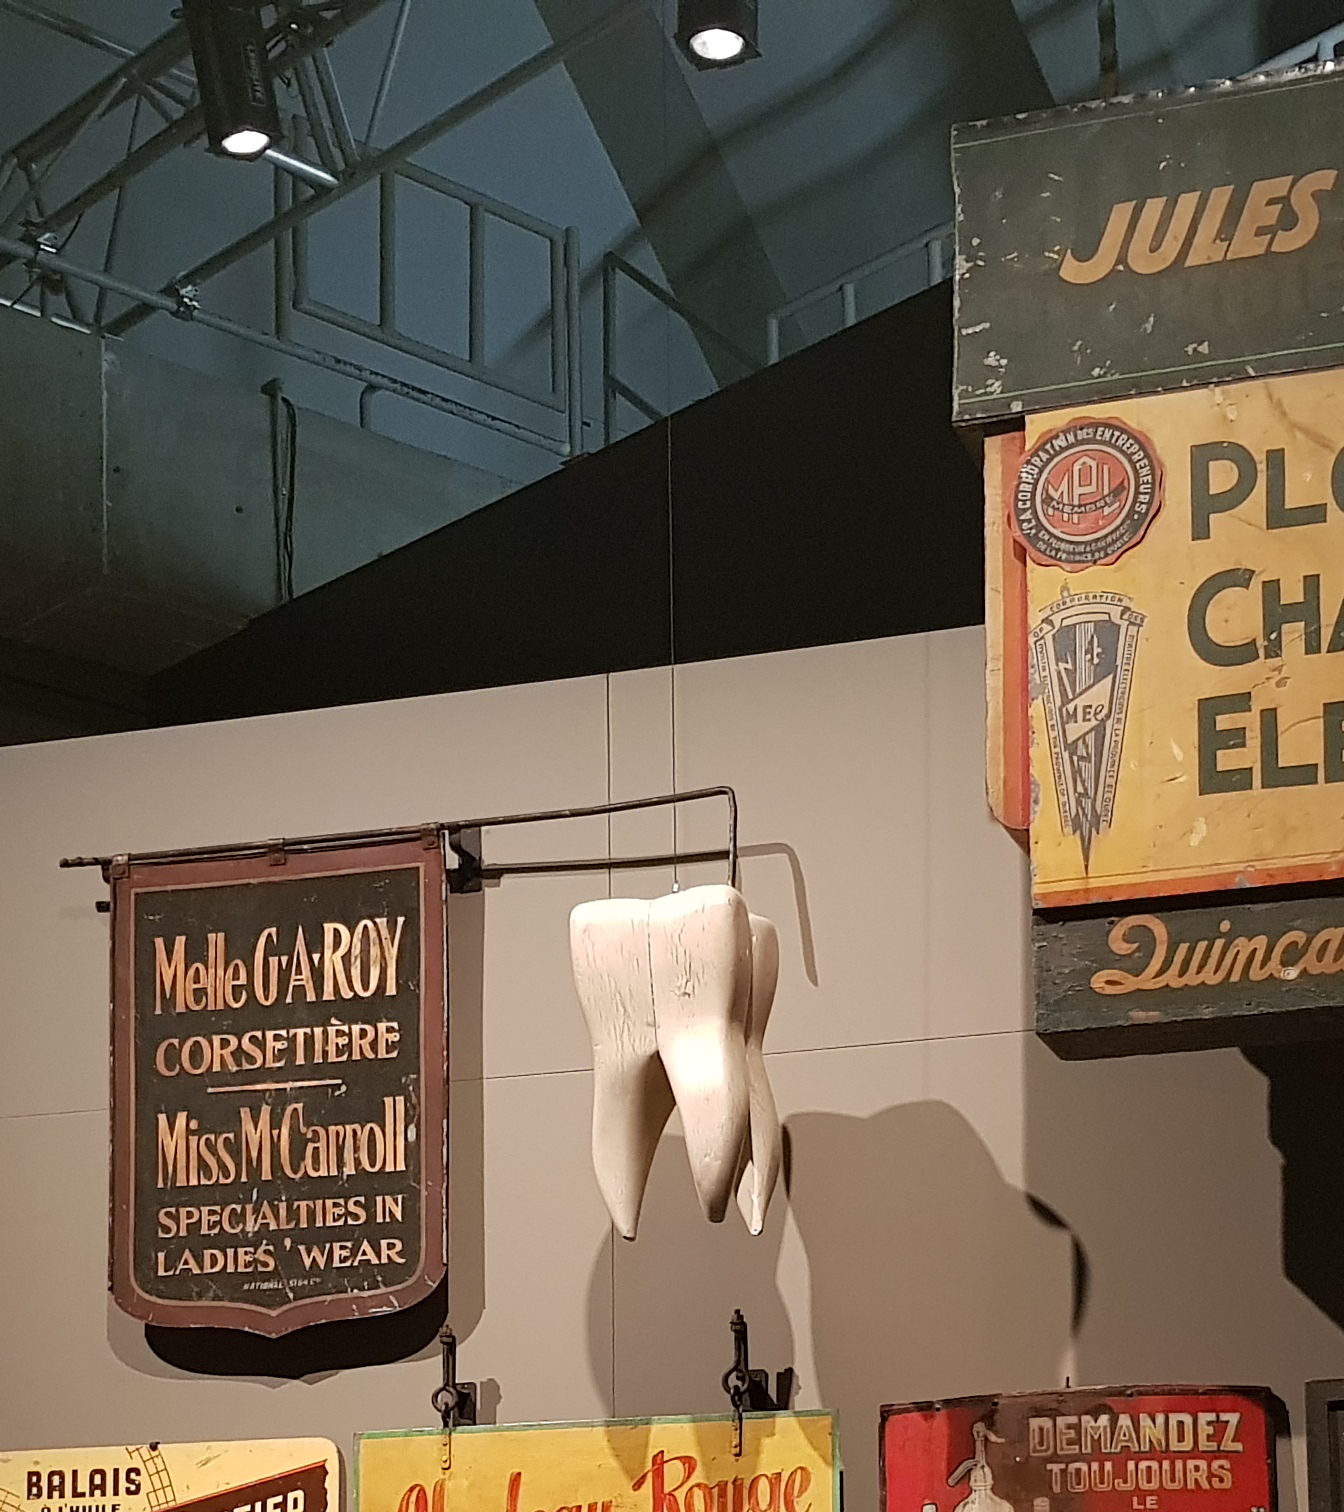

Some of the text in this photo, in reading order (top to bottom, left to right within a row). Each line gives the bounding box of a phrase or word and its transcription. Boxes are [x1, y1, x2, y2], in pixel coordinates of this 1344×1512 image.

[1059, 169, 1338, 285] JULES
[1096, 427, 1153, 514] ENTREPRENEURS
[156, 1017, 401, 1077] CORSETIÈRE
[156, 1110, 236, 1189] Miss
[158, 1193, 404, 1238] SPECIALTIES IN
[297, 1238, 408, 1268] WEAR
[1028, 1411, 1245, 1457] DEMANDEZ
[26, 1466, 142, 1501] BALAIS
[1046, 1458, 1233, 1494] TOUJOURS
[1131, 1495, 1160, 1511] LE
